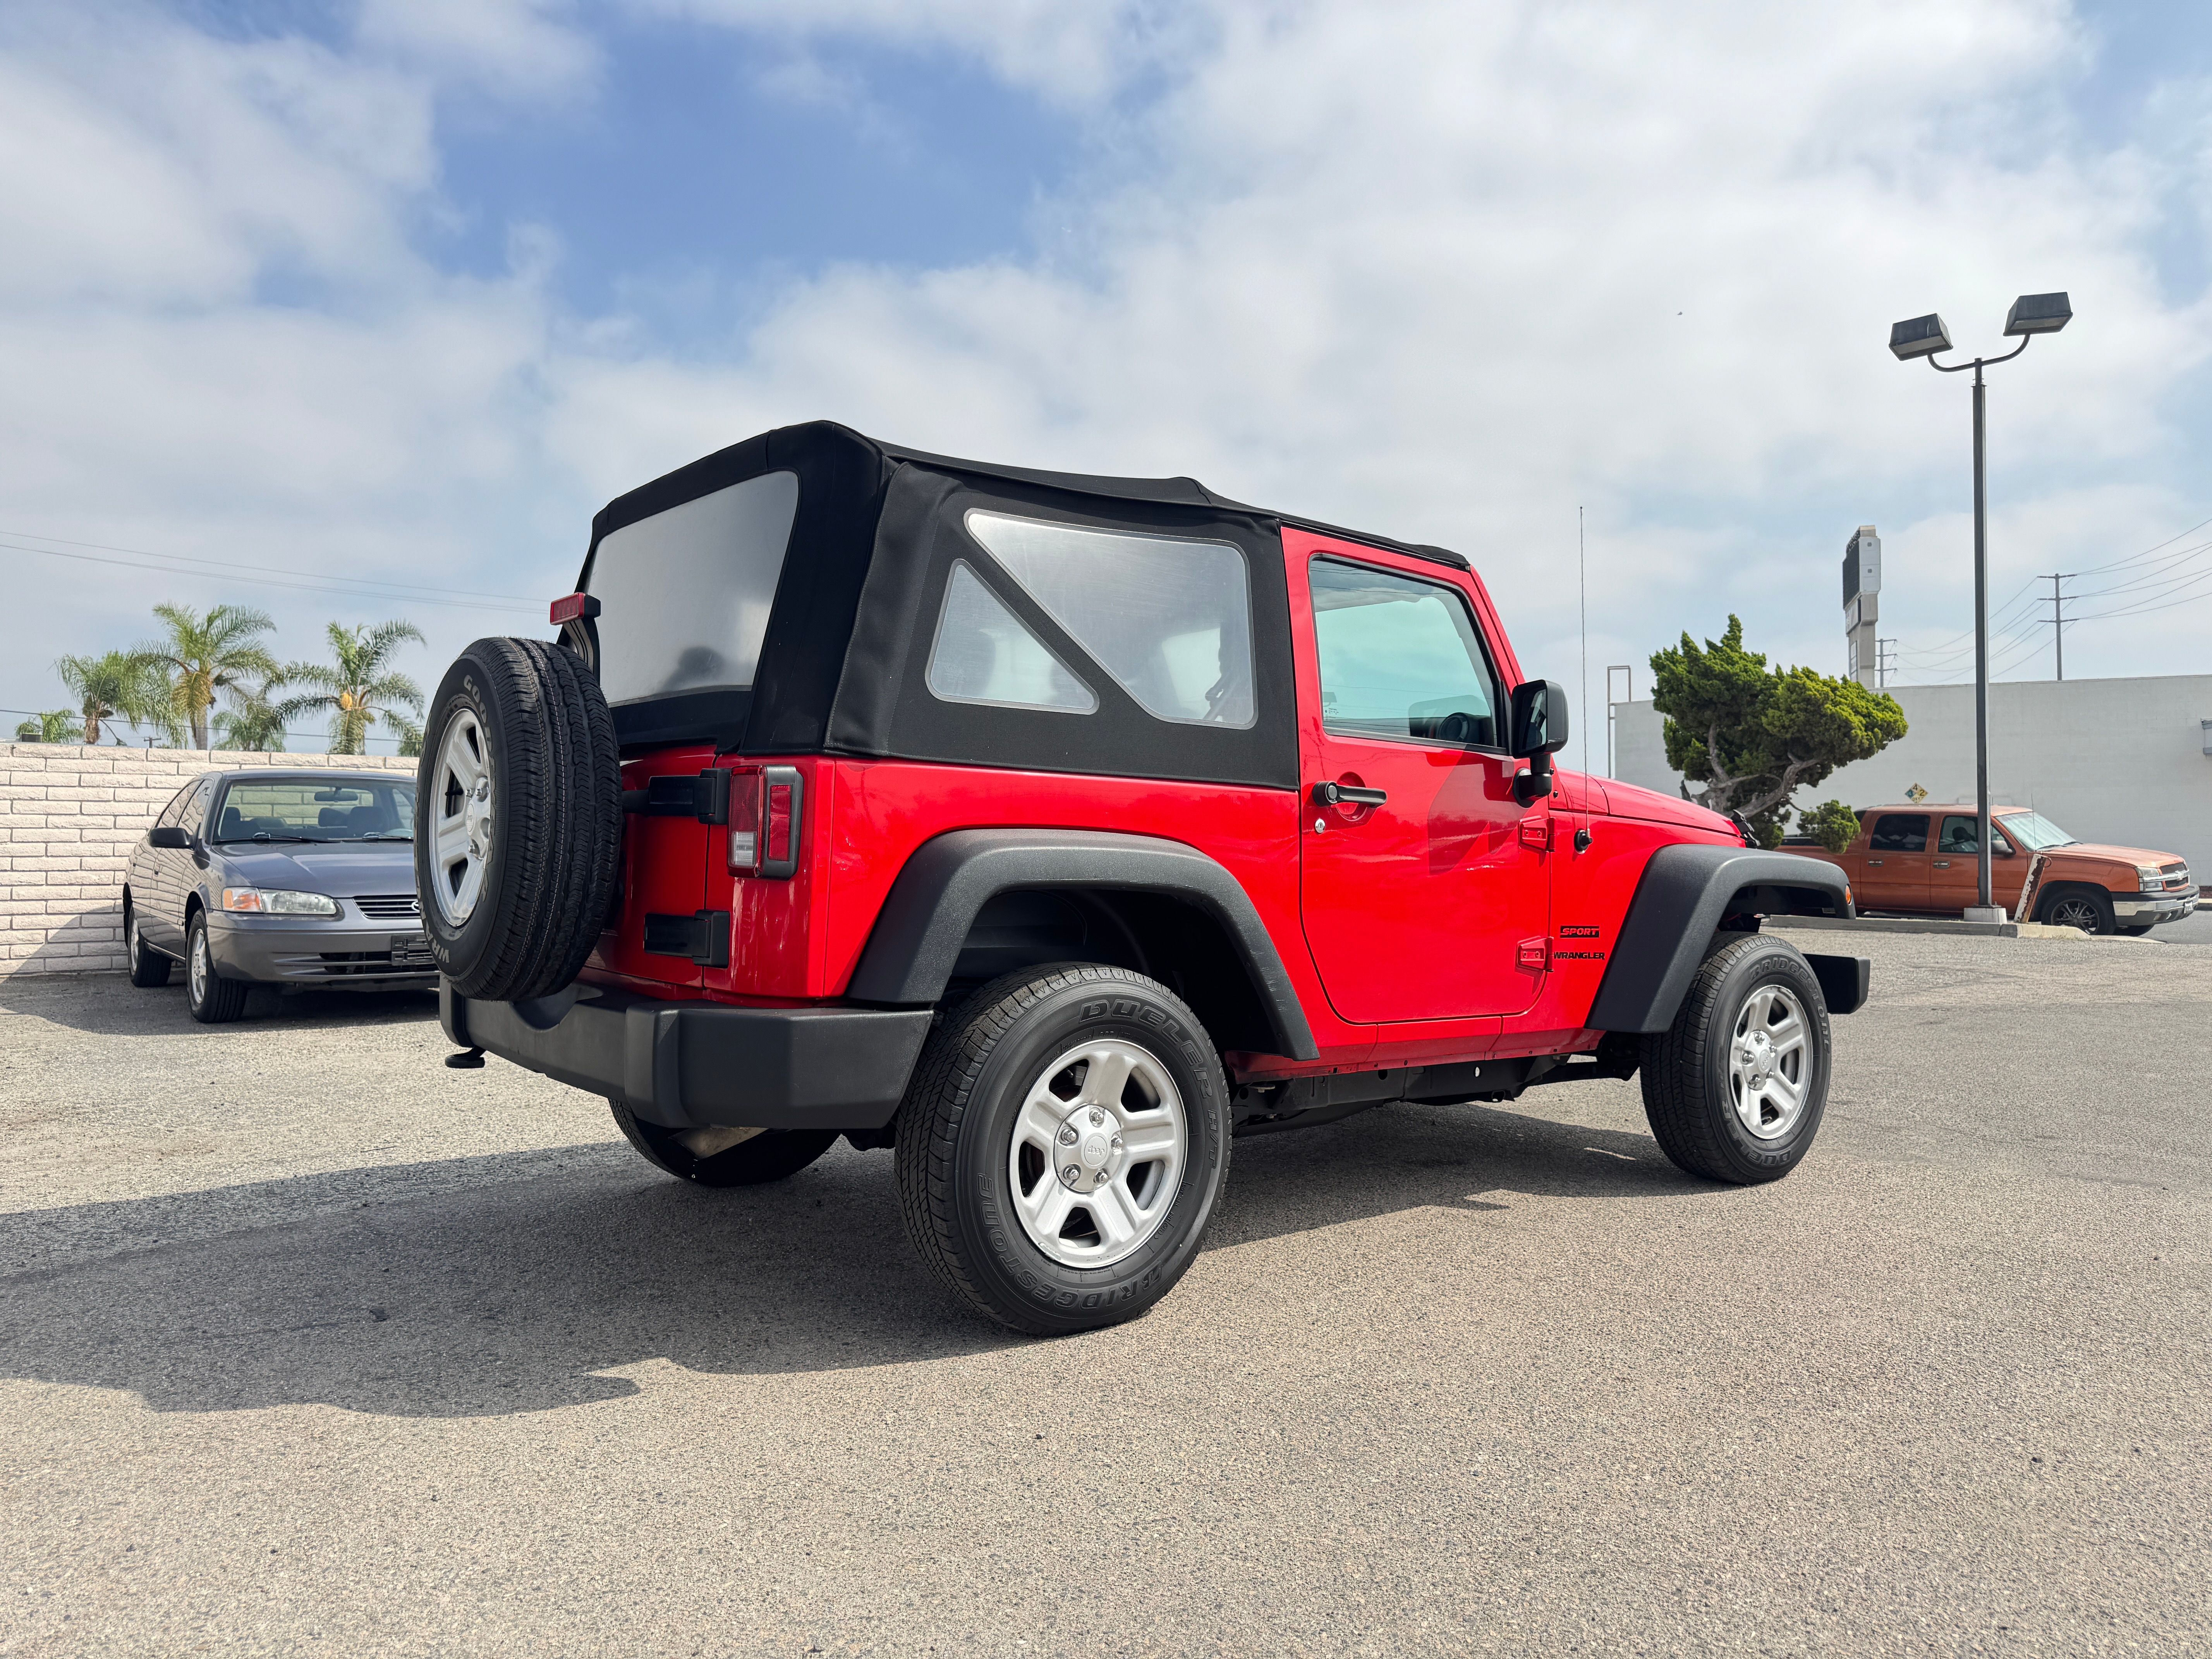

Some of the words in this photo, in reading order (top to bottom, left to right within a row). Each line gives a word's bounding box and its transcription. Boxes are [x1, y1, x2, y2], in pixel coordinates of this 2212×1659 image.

[1554, 951, 1605, 960] WRANGLER
[1079, 999, 1213, 1099] DUELER
[1087, 1145, 1105, 1157] Jeep
[976, 1173, 1162, 1310] BRIDGESTONE
